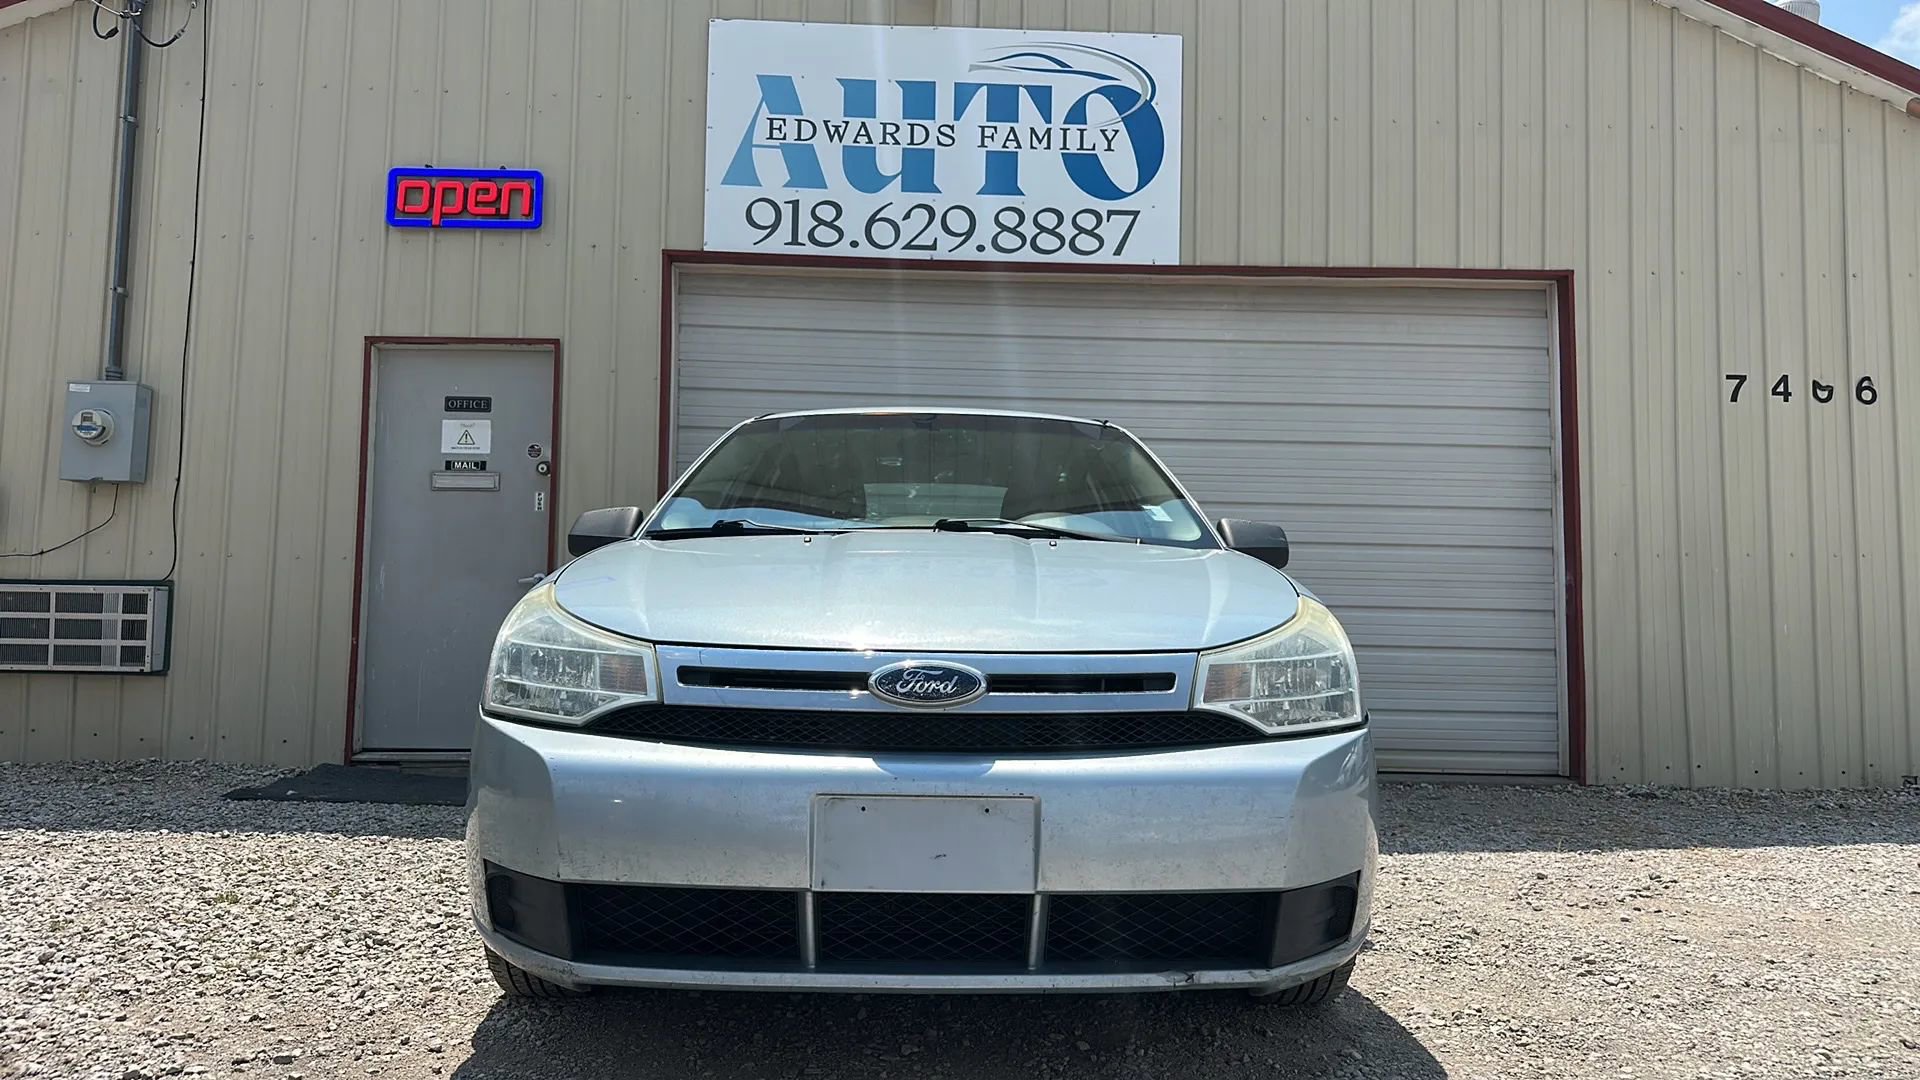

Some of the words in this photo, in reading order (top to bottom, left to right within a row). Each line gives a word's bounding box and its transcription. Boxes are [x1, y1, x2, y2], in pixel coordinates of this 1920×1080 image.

[720, 73, 1165, 201] AUTO
[766, 117, 956, 148] EDWARDS
[977, 125, 1121, 152] FAMILY
[397, 179, 533, 227] open
[744, 197, 1141, 257] 918.629.8887
[448, 399, 489, 409] OFFICE
[454, 461, 477, 470] MAIL
[895, 668, 959, 694] Ford
